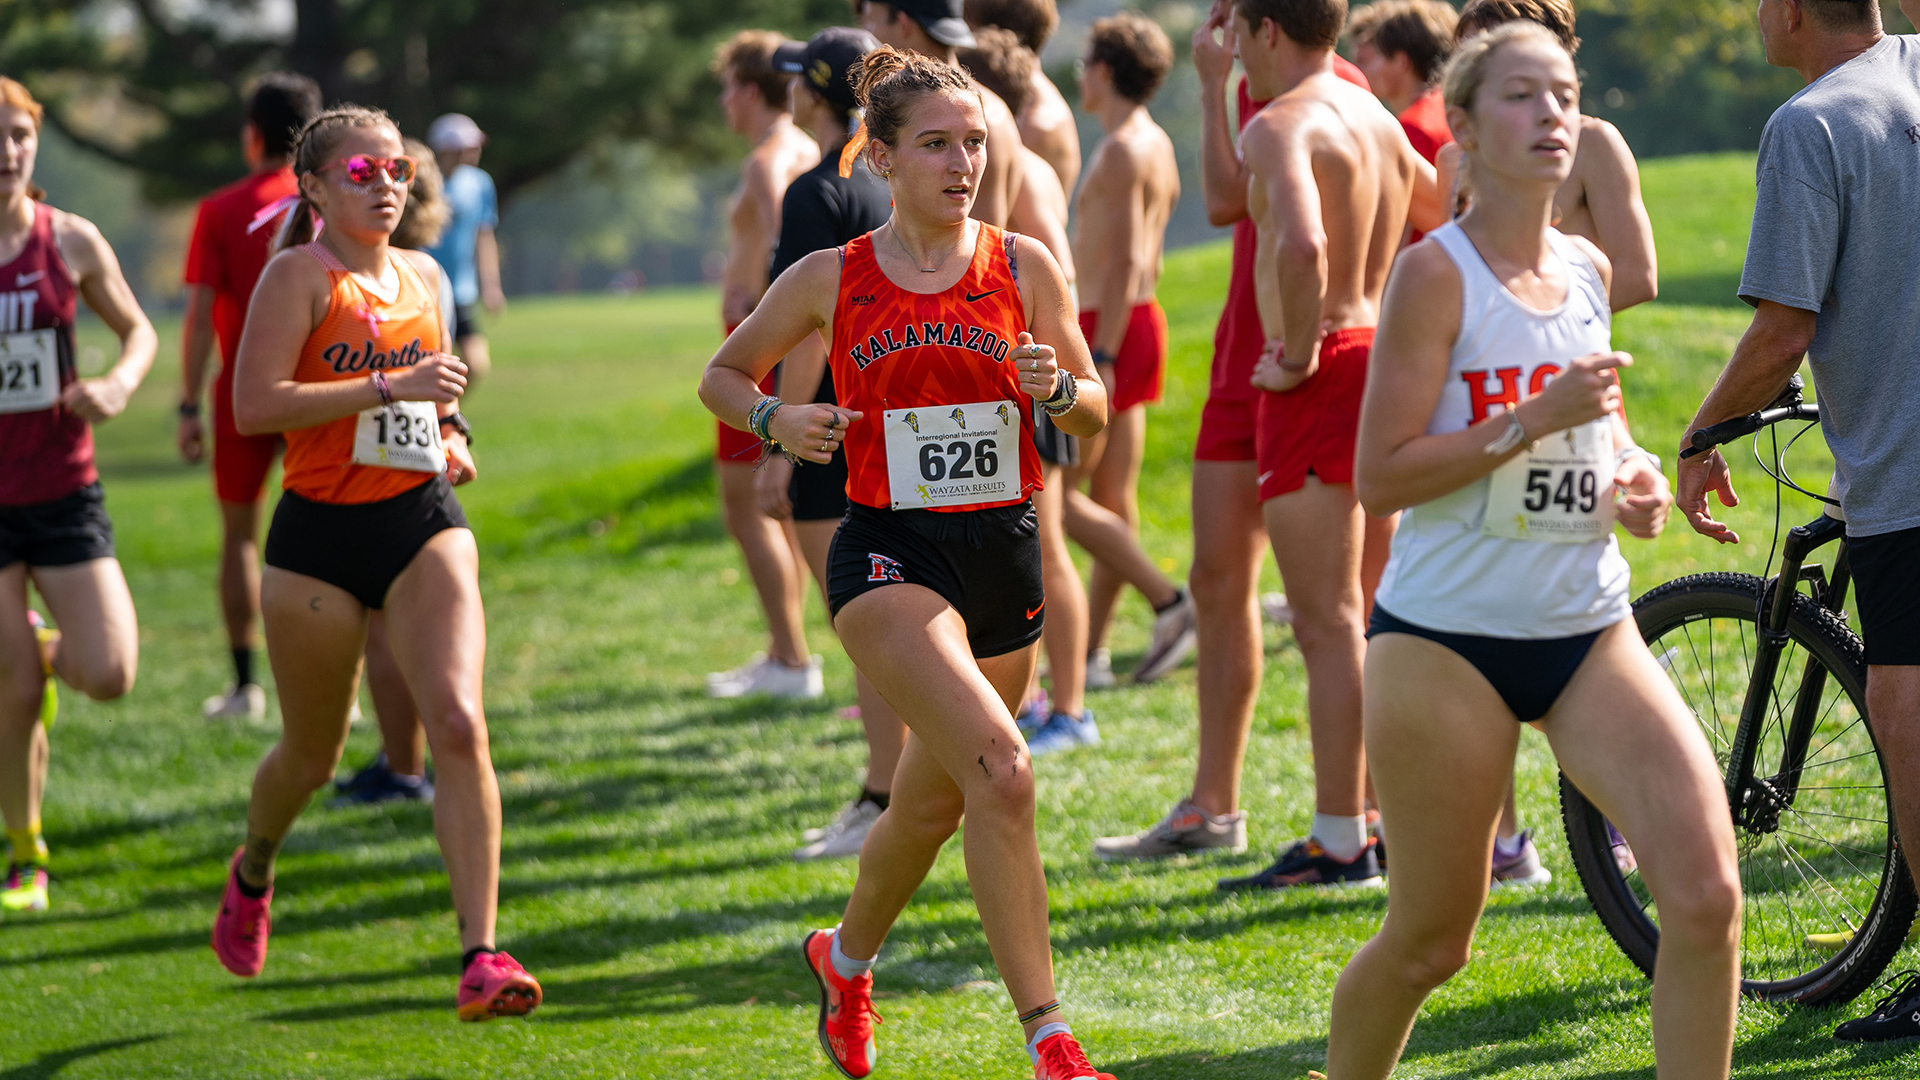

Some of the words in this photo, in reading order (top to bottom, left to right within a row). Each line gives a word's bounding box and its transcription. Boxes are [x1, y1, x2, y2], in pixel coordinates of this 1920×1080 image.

[851, 294, 876, 304] MIAA
[849, 322, 1010, 371] KALAMAZOO
[0, 357, 42, 391] 21
[915, 432, 960, 442] Interregional
[961, 429, 998, 439] Invitational
[919, 438, 999, 482] 626
[928, 484, 970, 495] WAYZATA
[972, 481, 1006, 492] RESULTS
[1524, 468, 1597, 514] 549
[1839, 902, 1886, 974] MEZCAL
